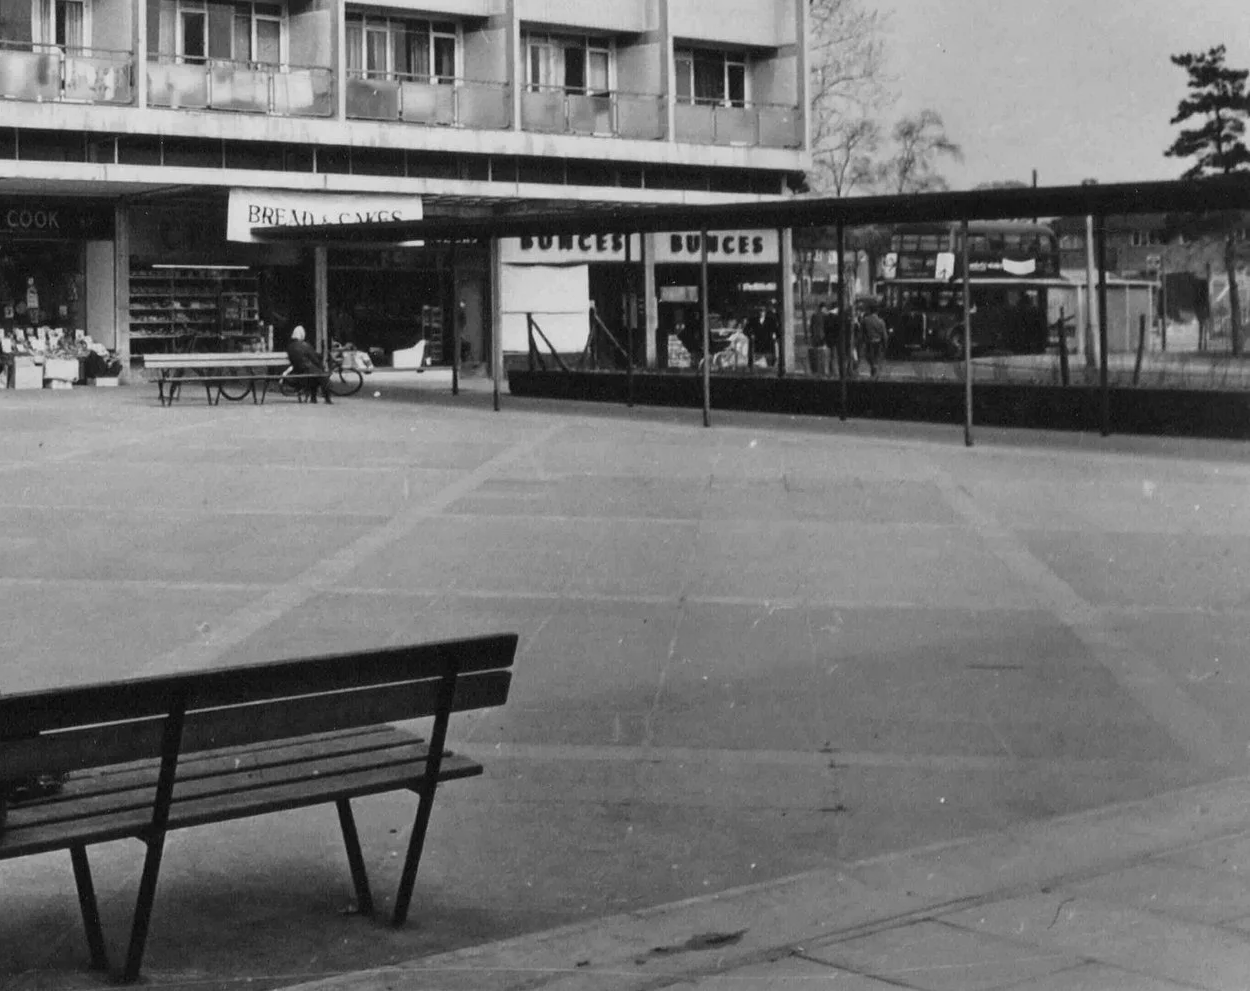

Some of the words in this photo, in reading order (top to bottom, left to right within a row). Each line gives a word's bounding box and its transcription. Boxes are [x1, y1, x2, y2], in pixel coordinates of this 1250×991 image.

[7, 210, 60, 229] COOK
[248, 205, 315, 226] BREAD
[670, 234, 763, 254] BUNCES
